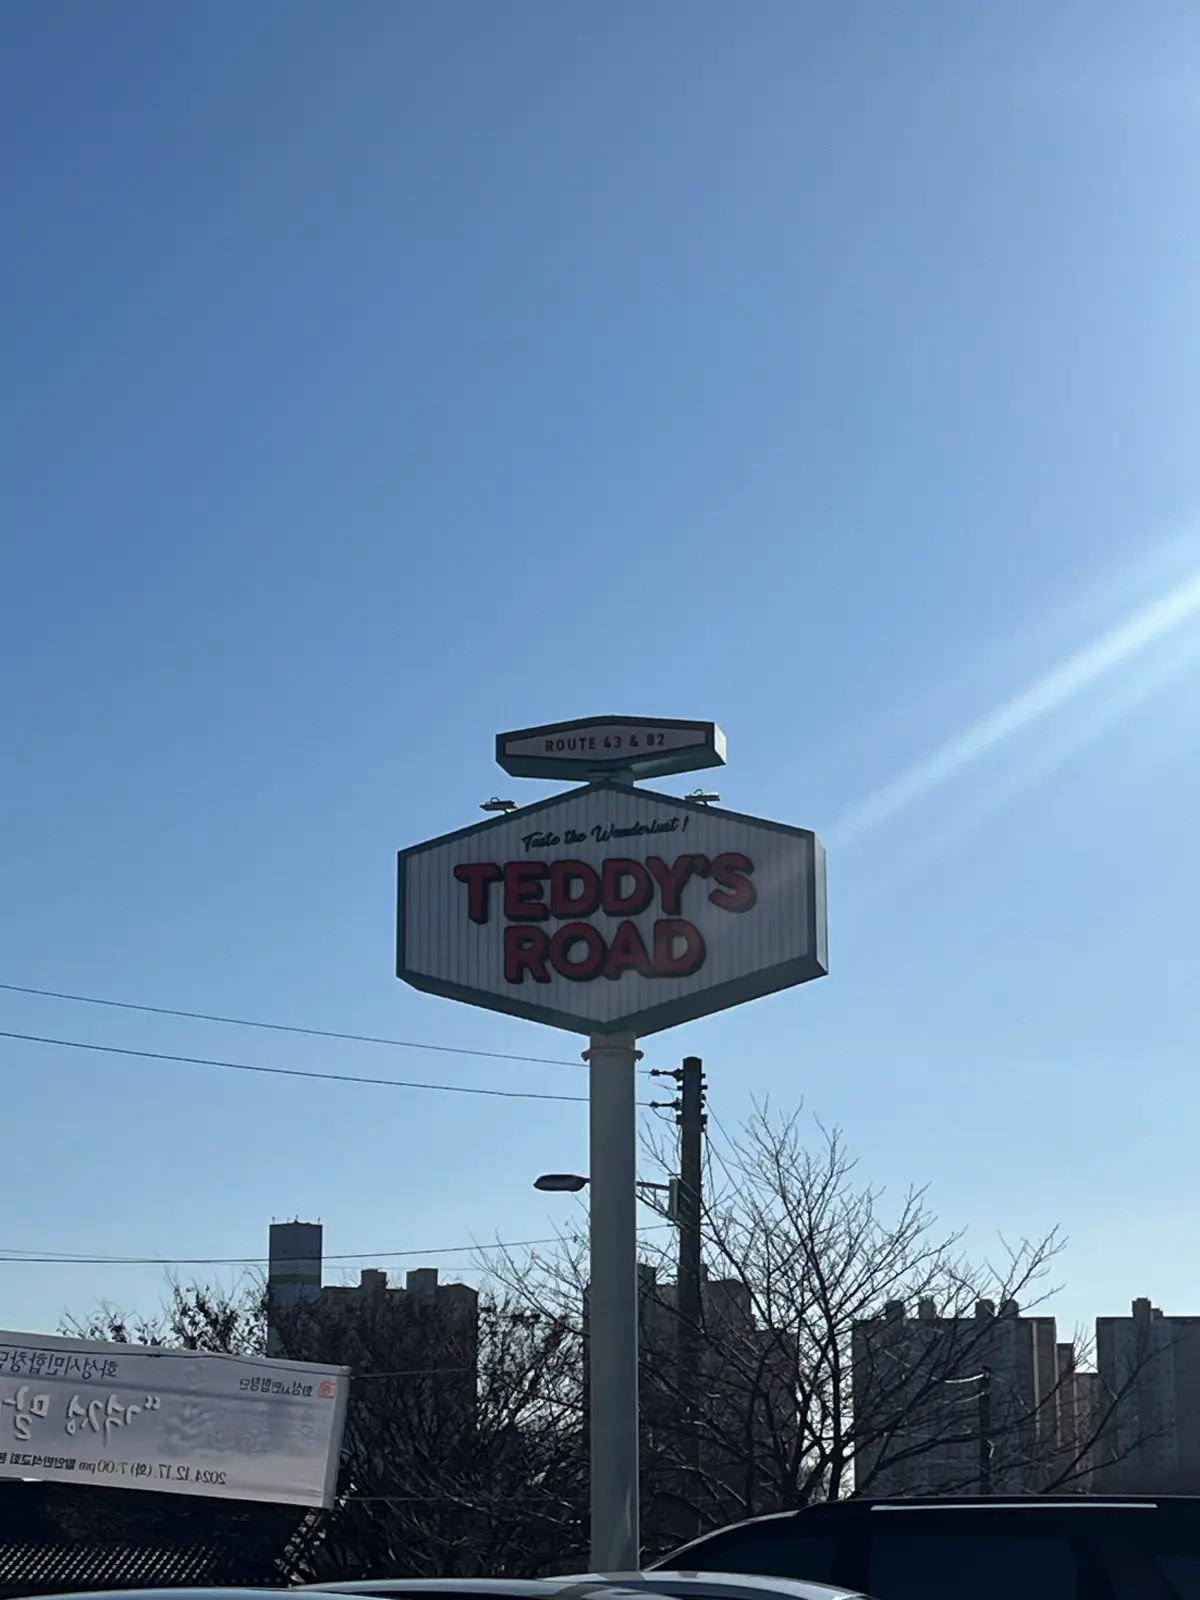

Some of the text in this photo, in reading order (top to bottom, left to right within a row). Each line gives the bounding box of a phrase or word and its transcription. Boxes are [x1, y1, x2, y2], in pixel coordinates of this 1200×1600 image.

[544, 737, 597, 752] ROUTE
[603, 735, 622, 749] 43
[629, 734, 639, 747] &
[521, 831, 560, 852] Taste
[564, 829, 587, 844] the
[453, 852, 757, 925] TEDDY'S
[503, 918, 707, 985] ROAD
